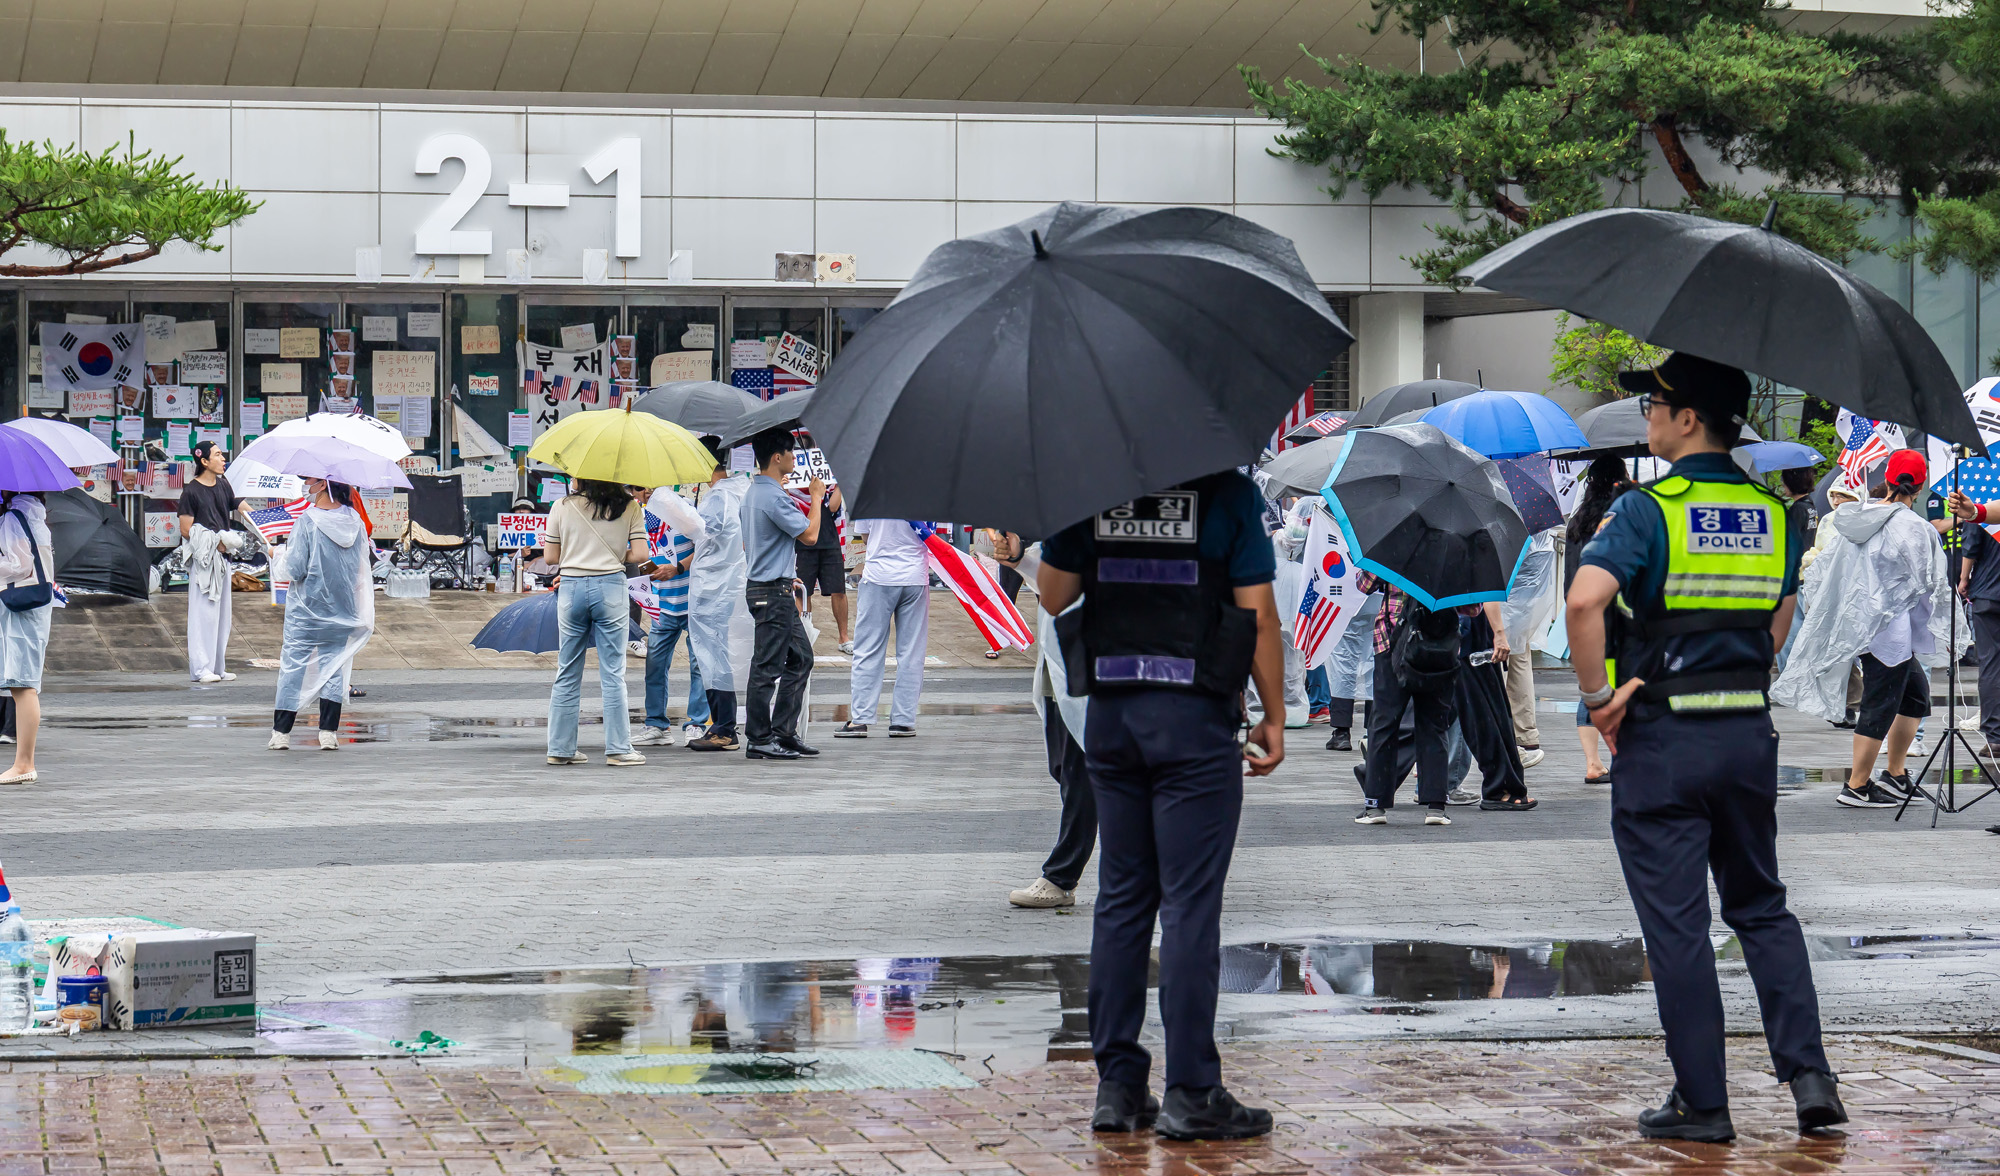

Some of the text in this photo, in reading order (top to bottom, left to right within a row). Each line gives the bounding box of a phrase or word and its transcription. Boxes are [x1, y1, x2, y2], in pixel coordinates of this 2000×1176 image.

[415, 133, 641, 257] 2-1
[378, 354, 409, 366] 투표용지
[655, 357, 690, 368] 투표용지
[777, 350, 815, 378] 수사해
[386, 367, 418, 378] 증거보존
[664, 370, 695, 380] 증거보존
[378, 381, 406, 394] 부정선거
[470, 377, 498, 392] 재선거
[257, 481, 281, 489] TRACK
[260, 475, 284, 483] TRIPLE
[500, 515, 547, 531] 부정선거
[1697, 508, 1761, 533] 경찰
[1109, 521, 1182, 536] POLICE
[500, 532, 537, 547] AWEB
[1698, 535, 1762, 548] POLICE
[220, 974, 248, 992] 잡곡
